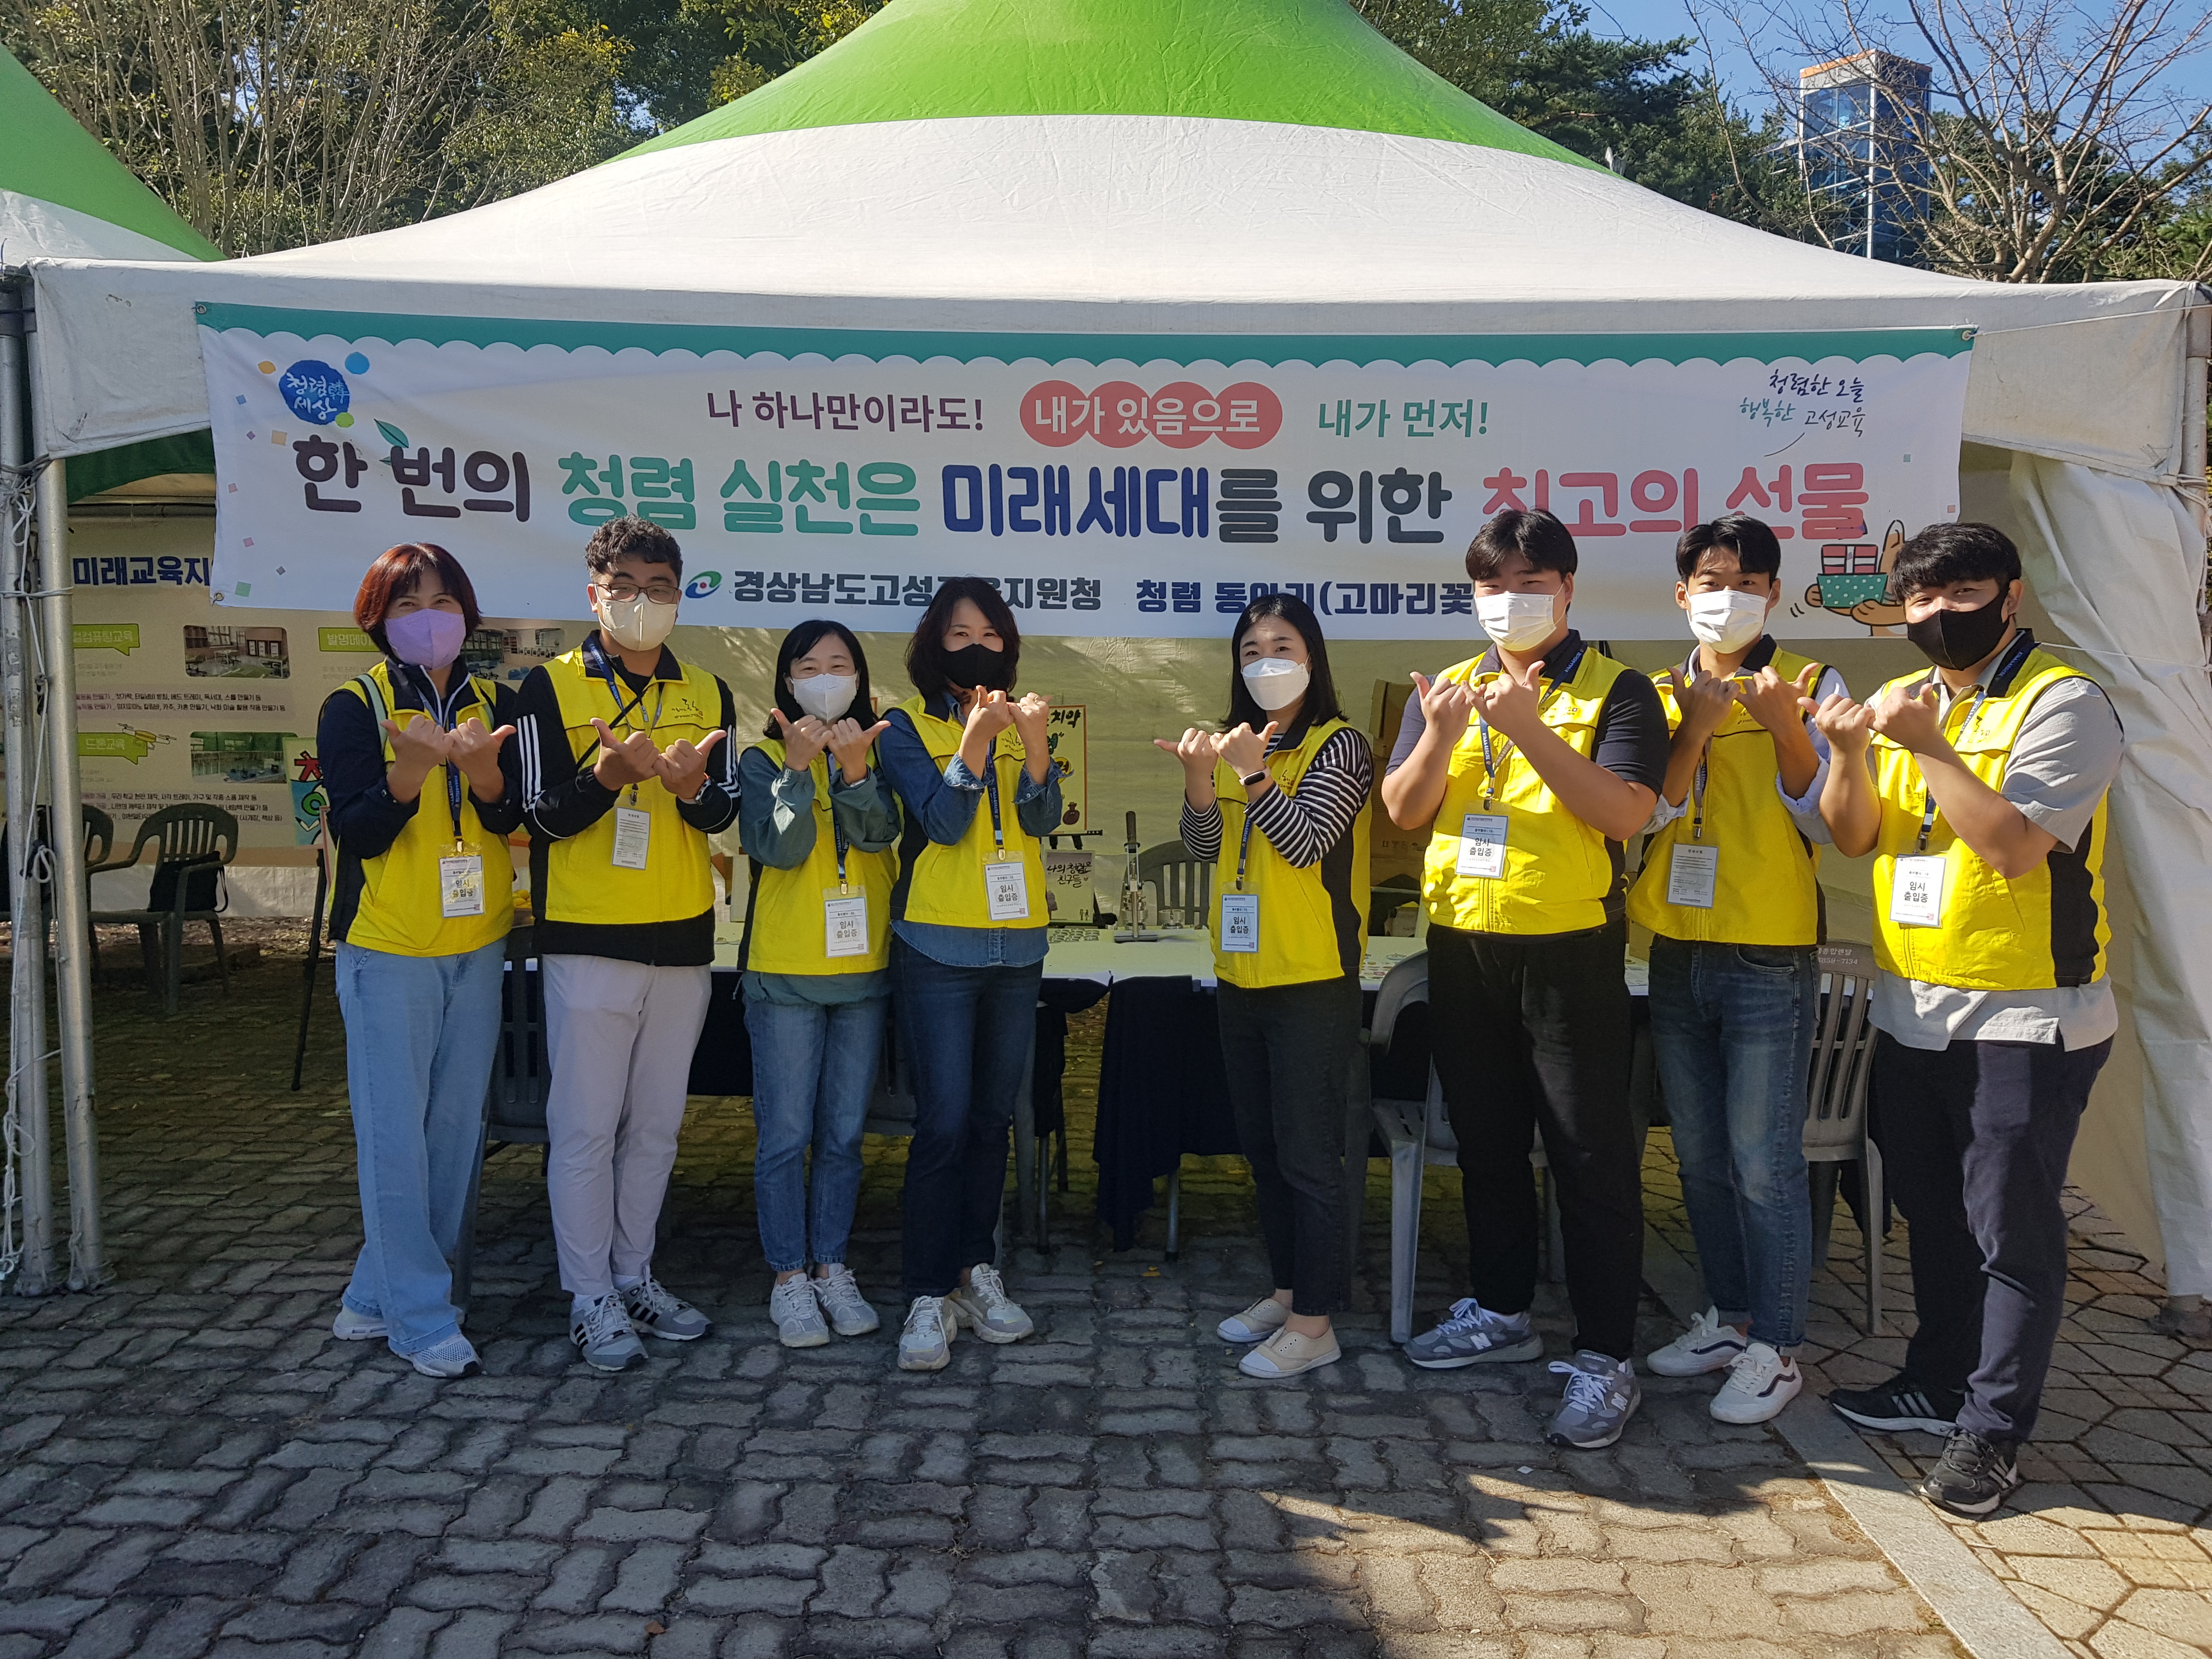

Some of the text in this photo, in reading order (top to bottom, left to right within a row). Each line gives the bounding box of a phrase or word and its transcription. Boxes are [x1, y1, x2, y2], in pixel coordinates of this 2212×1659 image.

[1769, 369, 1865, 403] 청렴한 오늘
[294, 396, 337, 420] 세상
[707, 390, 984, 432] 나 하나만이라도!
[1035, 395, 1261, 435] 내가 있음으로
[1318, 398, 1489, 438] 내가 먼저!
[1740, 397, 1866, 437] 행복한 고성교육
[292, 434, 368, 513] 한
[390, 445, 531, 522] 번의
[558, 451, 697, 530] 청렴
[719, 458, 921, 537] 실천은
[941, 462, 1283, 543] 미래세대를
[1306, 467, 1453, 544] 위한
[1725, 462, 1869, 540] 선물
[73, 556, 213, 586] 미래교육지
[1136, 579, 1202, 613] 청렴
[328, 634, 374, 646] 발명메이
[1475, 838, 1489, 847] 임시
[1470, 847, 1492, 856] 출입증
[1047, 861, 1092, 874] 나의 청렴은
[456, 879, 469, 888] 임시
[1057, 874, 1082, 888] 친구들
[1910, 881, 1925, 891] 임시
[1000, 884, 1013, 893] 임시
[998, 893, 1018, 902] 출입증
[1904, 891, 1928, 902] 출입증
[839, 920, 854, 929] 임시
[1233, 916, 1246, 924] 임시
[1230, 926, 1249, 934] 출입증
[1470, 1332, 1492, 1350] N
[1611, 1392, 1628, 1412] N
